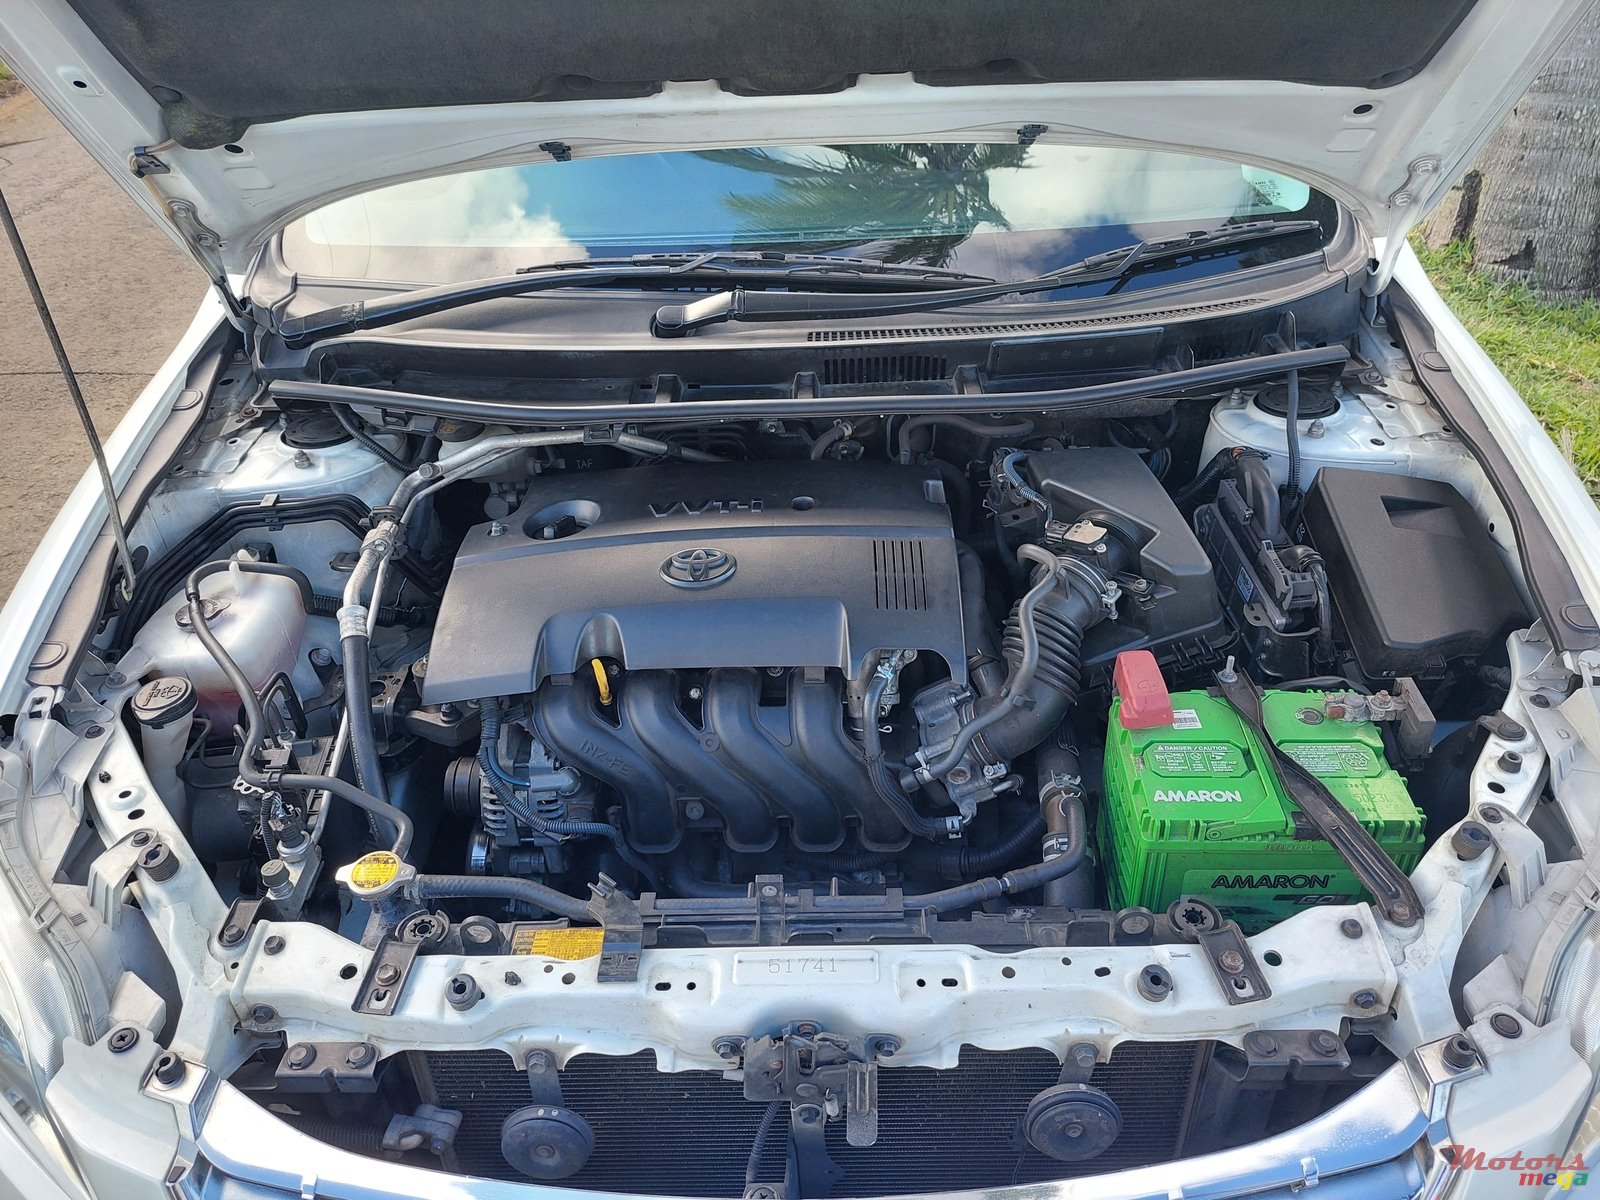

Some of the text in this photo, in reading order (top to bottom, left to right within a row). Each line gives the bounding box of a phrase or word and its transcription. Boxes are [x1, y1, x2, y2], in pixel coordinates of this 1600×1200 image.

[1153, 789, 1243, 803] AMARON
[1211, 874, 1330, 889] AMARON
[768, 957, 837, 974] 51741
